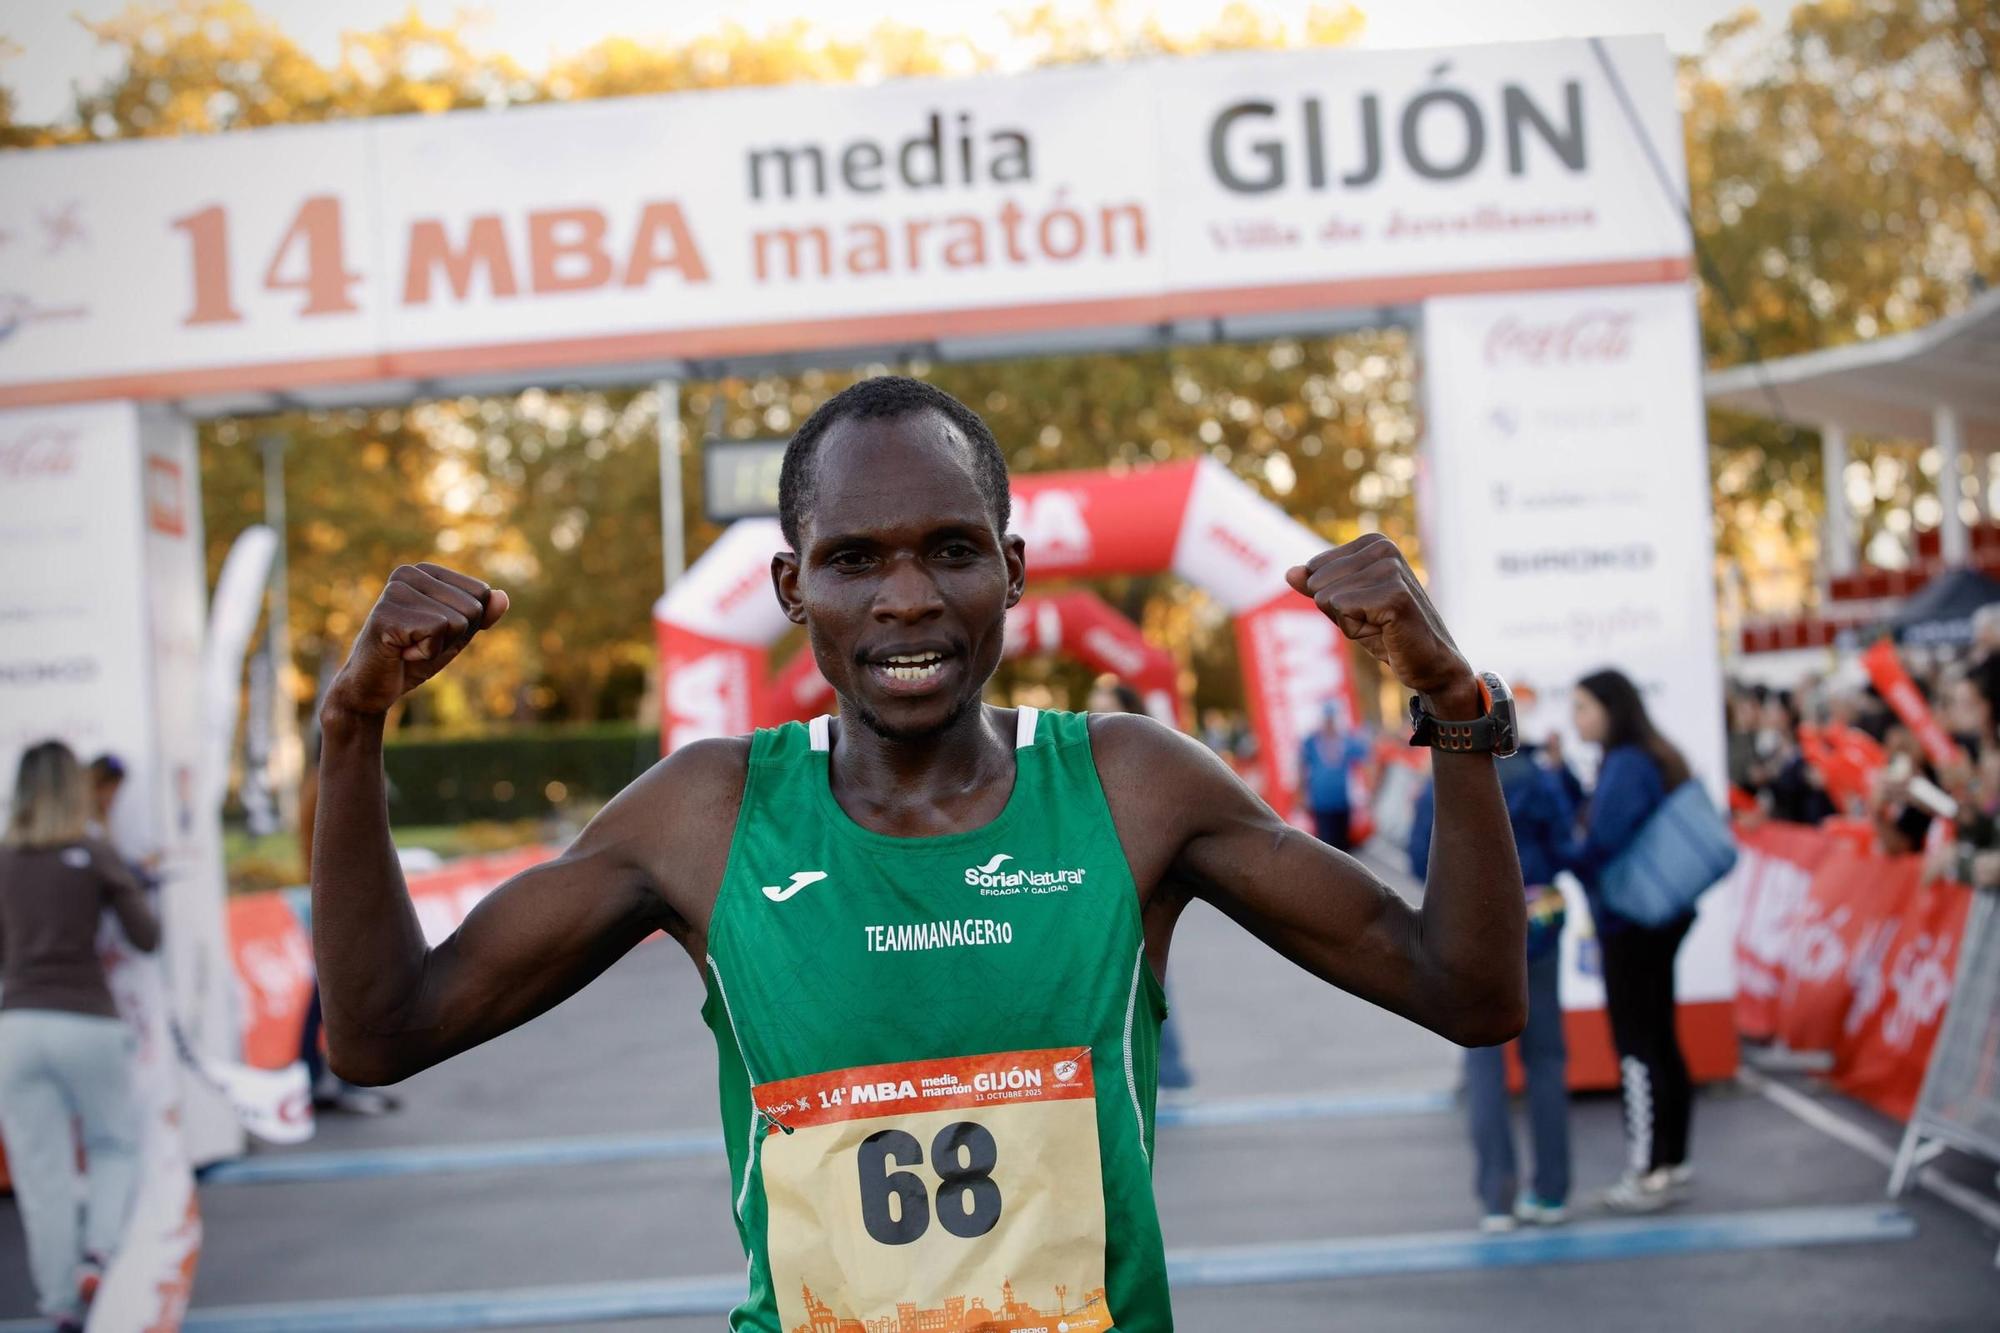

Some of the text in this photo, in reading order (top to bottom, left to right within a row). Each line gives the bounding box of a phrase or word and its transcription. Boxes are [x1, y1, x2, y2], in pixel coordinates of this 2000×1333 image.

[1208, 60, 1587, 195] GIJÓN
[746, 112, 1034, 199] media
[751, 187, 1150, 283] maratón
[170, 193, 709, 327] 14 MBA
[980, 887, 1021, 897] EFICACIA
[1030, 884, 1069, 895] CALIDAD
[864, 918, 1013, 952] TEAMMANAGER10
[850, 1079, 918, 1106] MBA
[921, 1073, 959, 1088] media
[922, 1082, 972, 1098] maratón
[973, 1065, 1042, 1093] GIJÓN
[975, 1087, 1043, 1102] 11 OCTUBRE 2025
[856, 1120, 1002, 1246] 68
